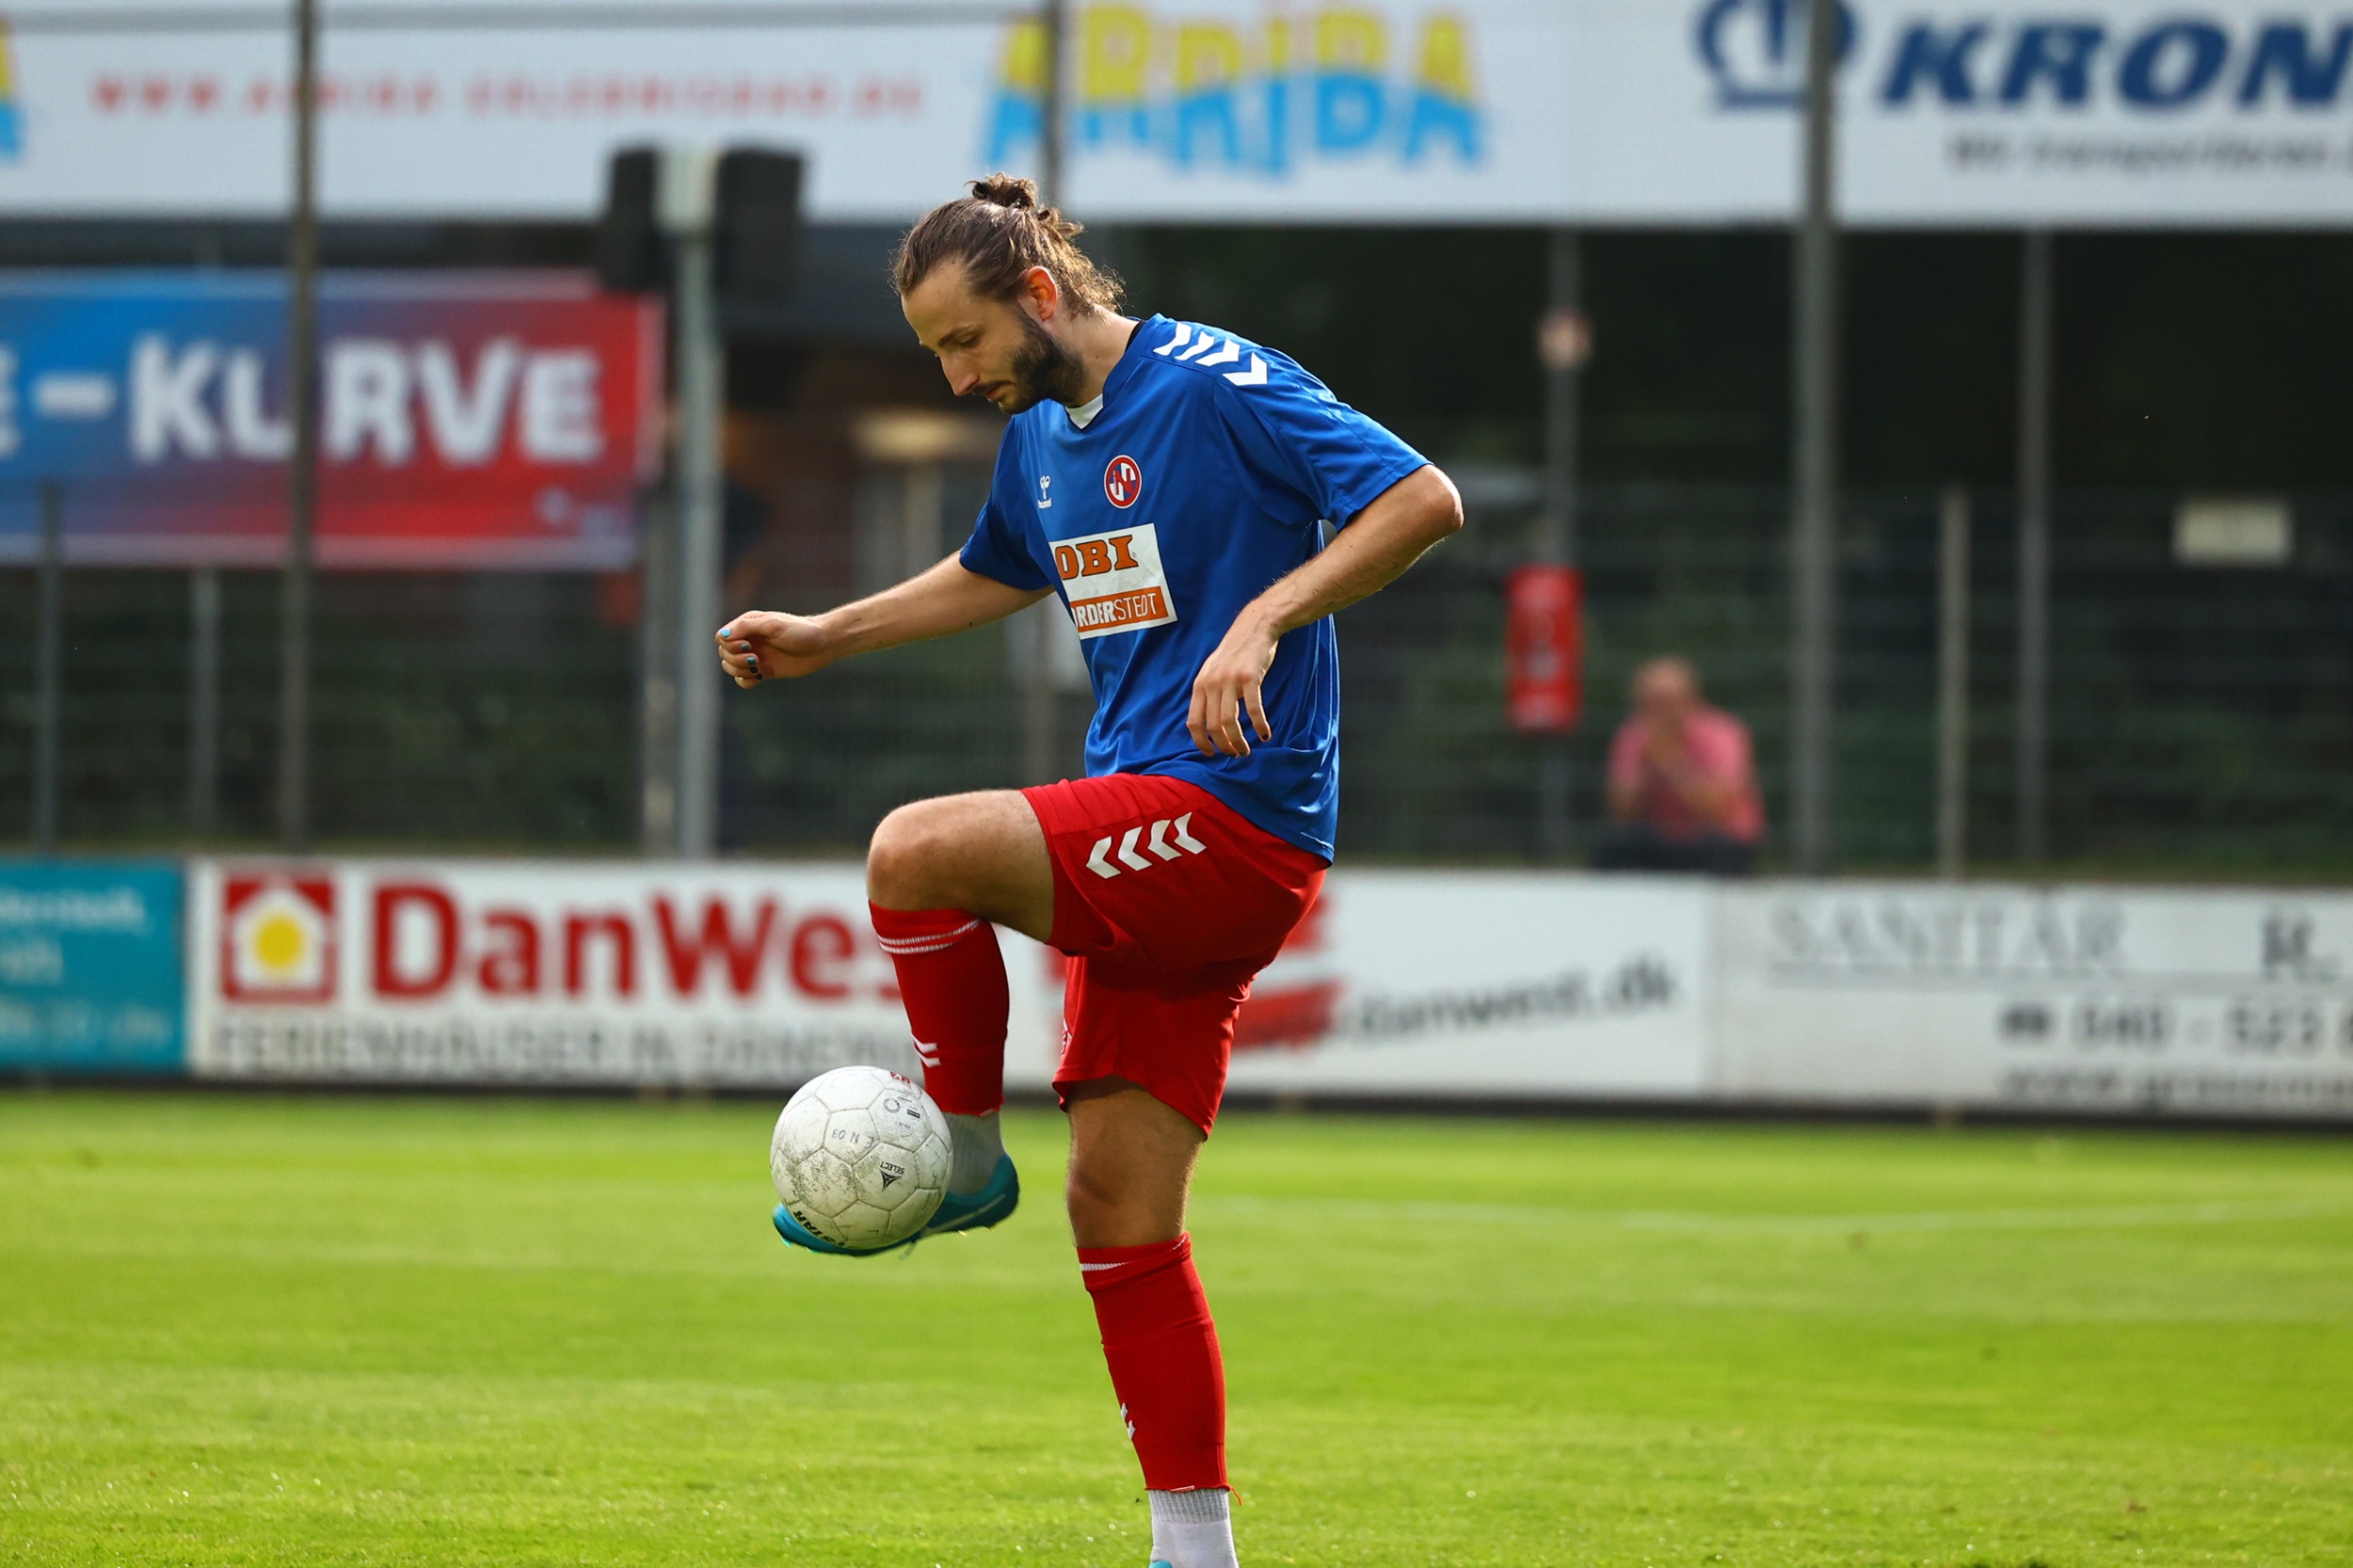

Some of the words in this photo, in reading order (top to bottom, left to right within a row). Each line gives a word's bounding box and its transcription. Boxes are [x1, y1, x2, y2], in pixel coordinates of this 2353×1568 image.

[1879, 20, 2353, 113] KRON
[0, 337, 603, 465] -KURVE
[1055, 534, 1139, 581] OBI
[374, 883, 902, 999] DanWe
[880, 1160, 905, 1175] SELECT
